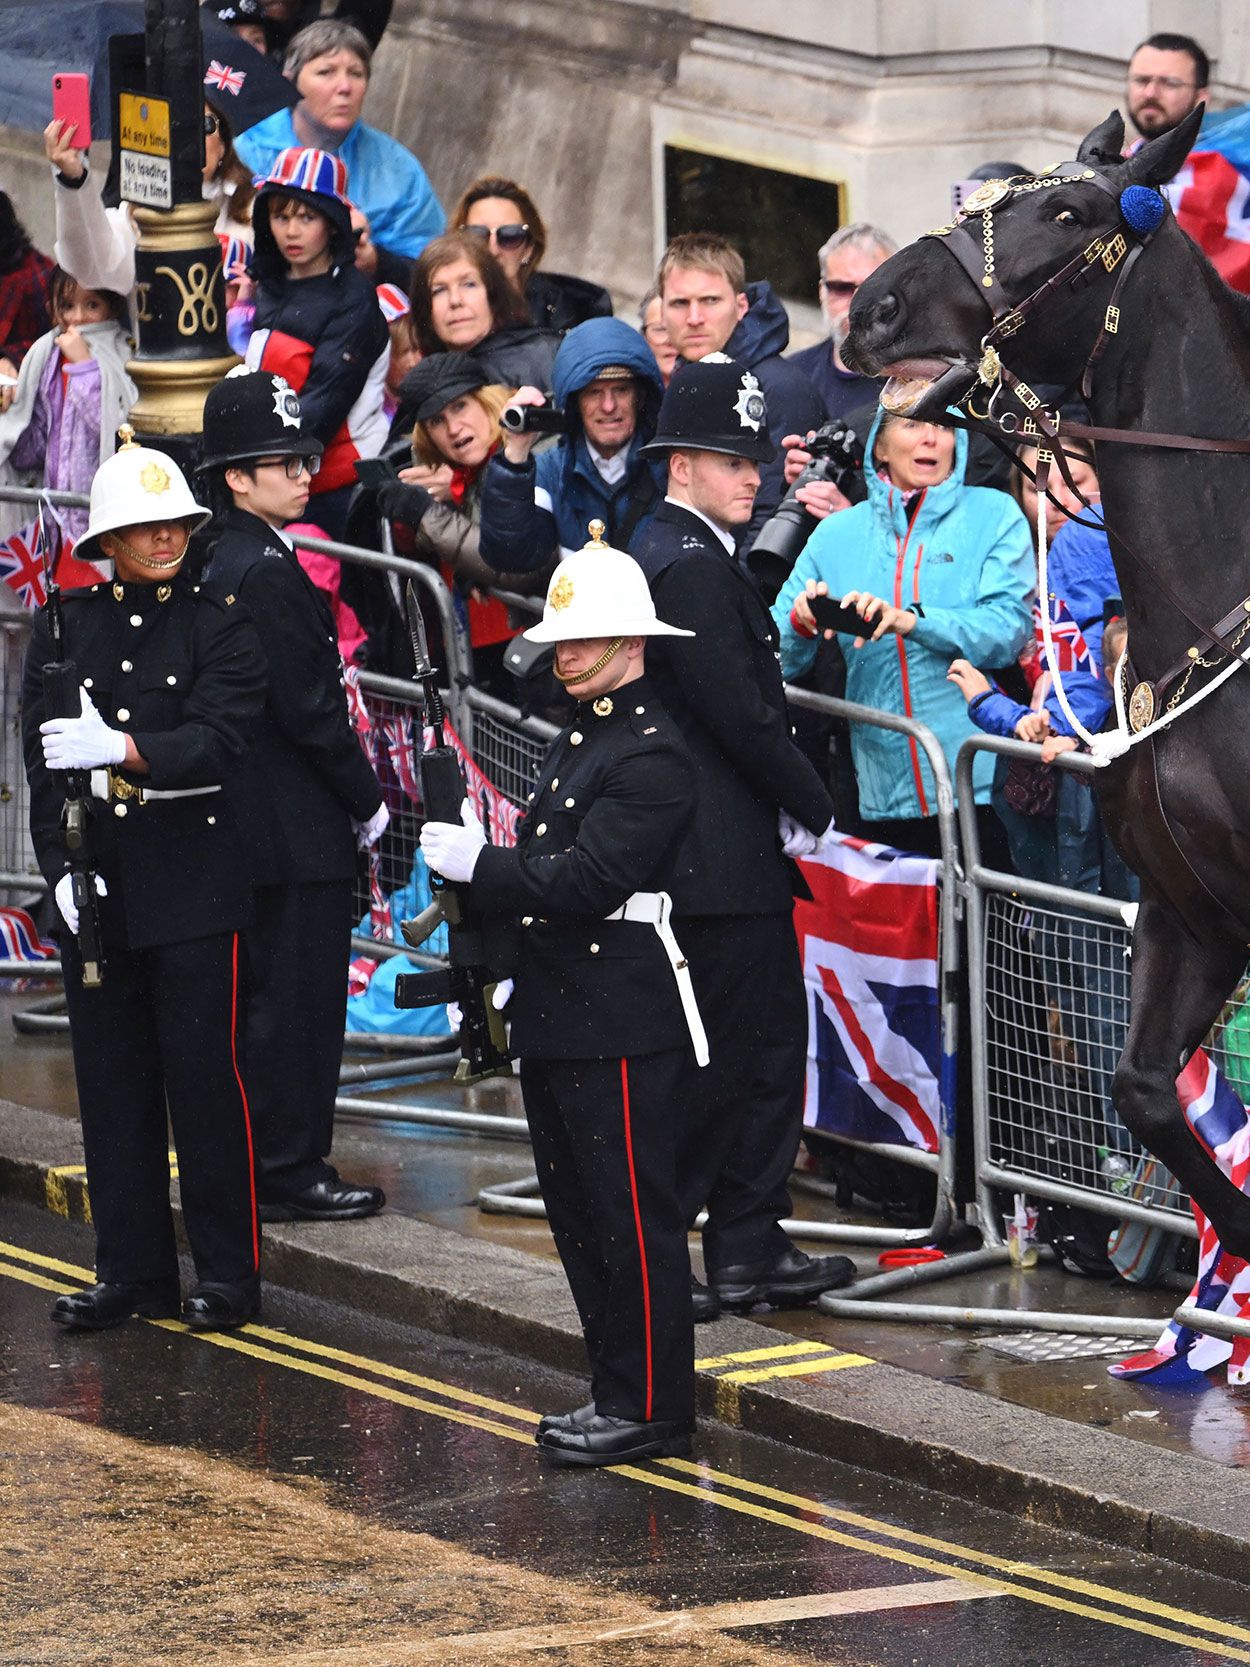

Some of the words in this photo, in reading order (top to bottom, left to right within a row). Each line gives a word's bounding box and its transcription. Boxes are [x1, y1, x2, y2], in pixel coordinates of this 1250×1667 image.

[121, 126, 131, 140] At
[133, 130, 148, 146] any
[149, 131, 167, 149] time
[124, 158, 135, 174] No
[137, 159, 167, 183] loading
[123, 178, 132, 192] at
[134, 182, 148, 197] any
[149, 183, 168, 199] time
